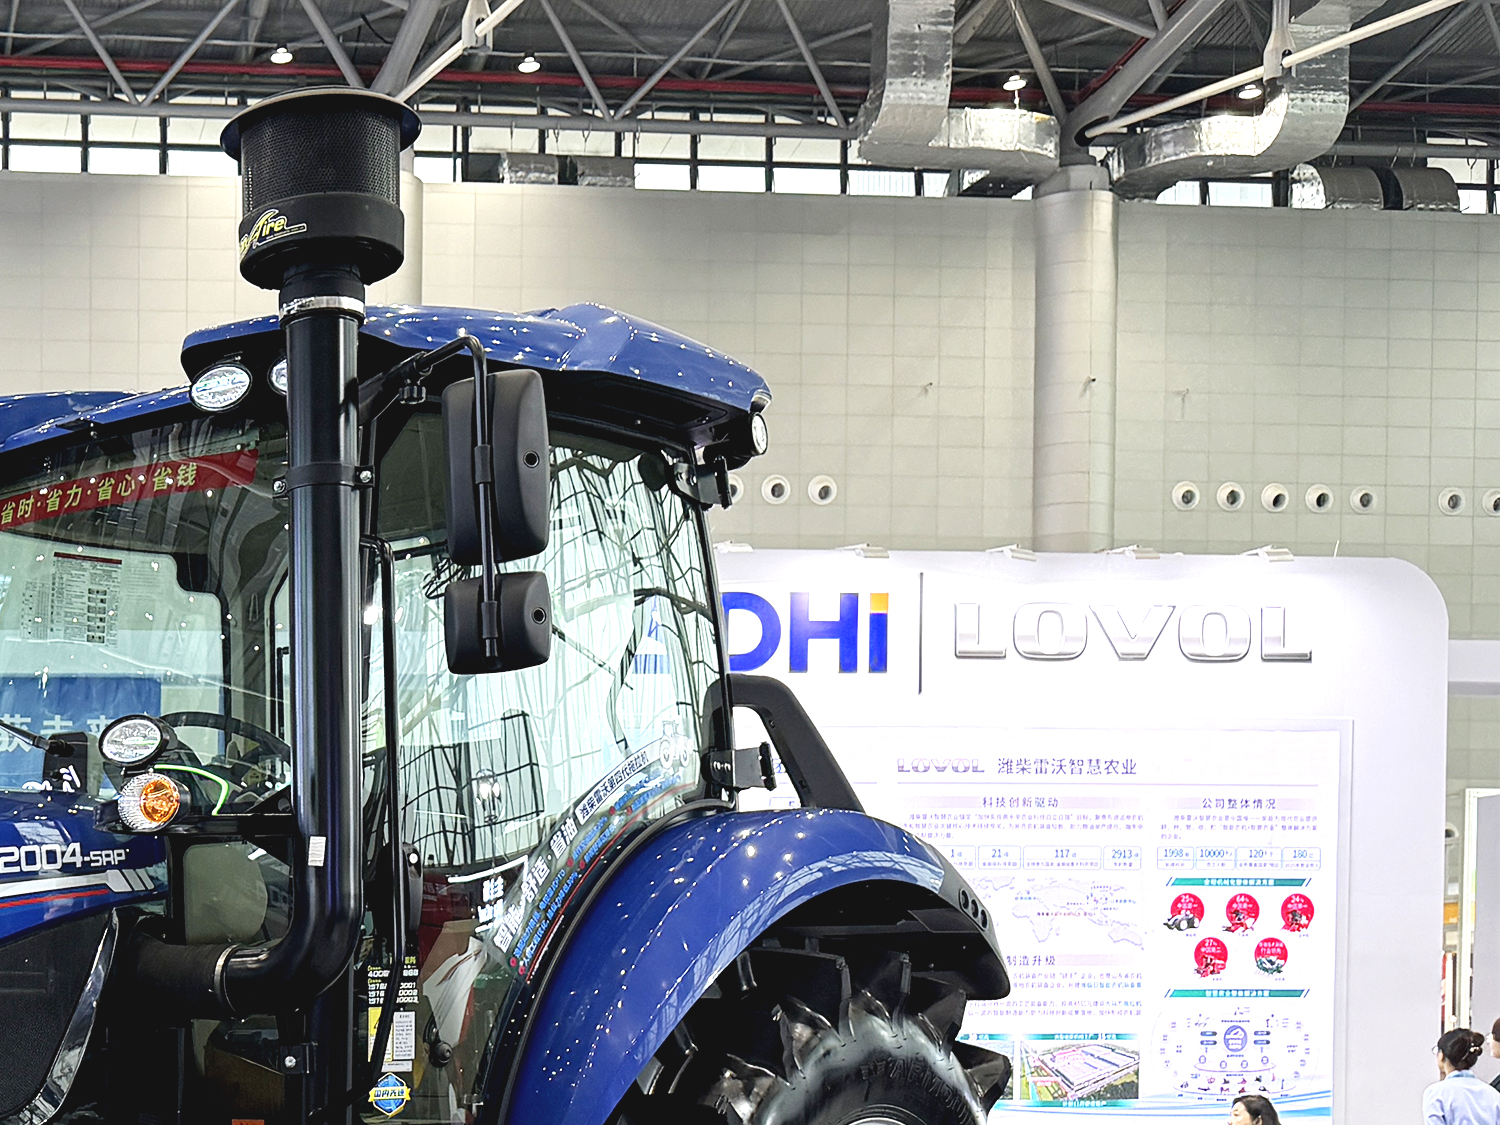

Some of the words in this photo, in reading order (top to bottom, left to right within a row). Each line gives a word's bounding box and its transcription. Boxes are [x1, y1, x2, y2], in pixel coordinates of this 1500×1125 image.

[633, 591, 889, 674] DHi
[953, 602, 1313, 663] LOVOL
[897, 758, 985, 773] LOVOL
[997, 757, 1137, 776] 潍柴雷沃智慧农业
[983, 797, 1059, 809] 科技创新驱动
[1202, 798, 1276, 809] 公司整体情况
